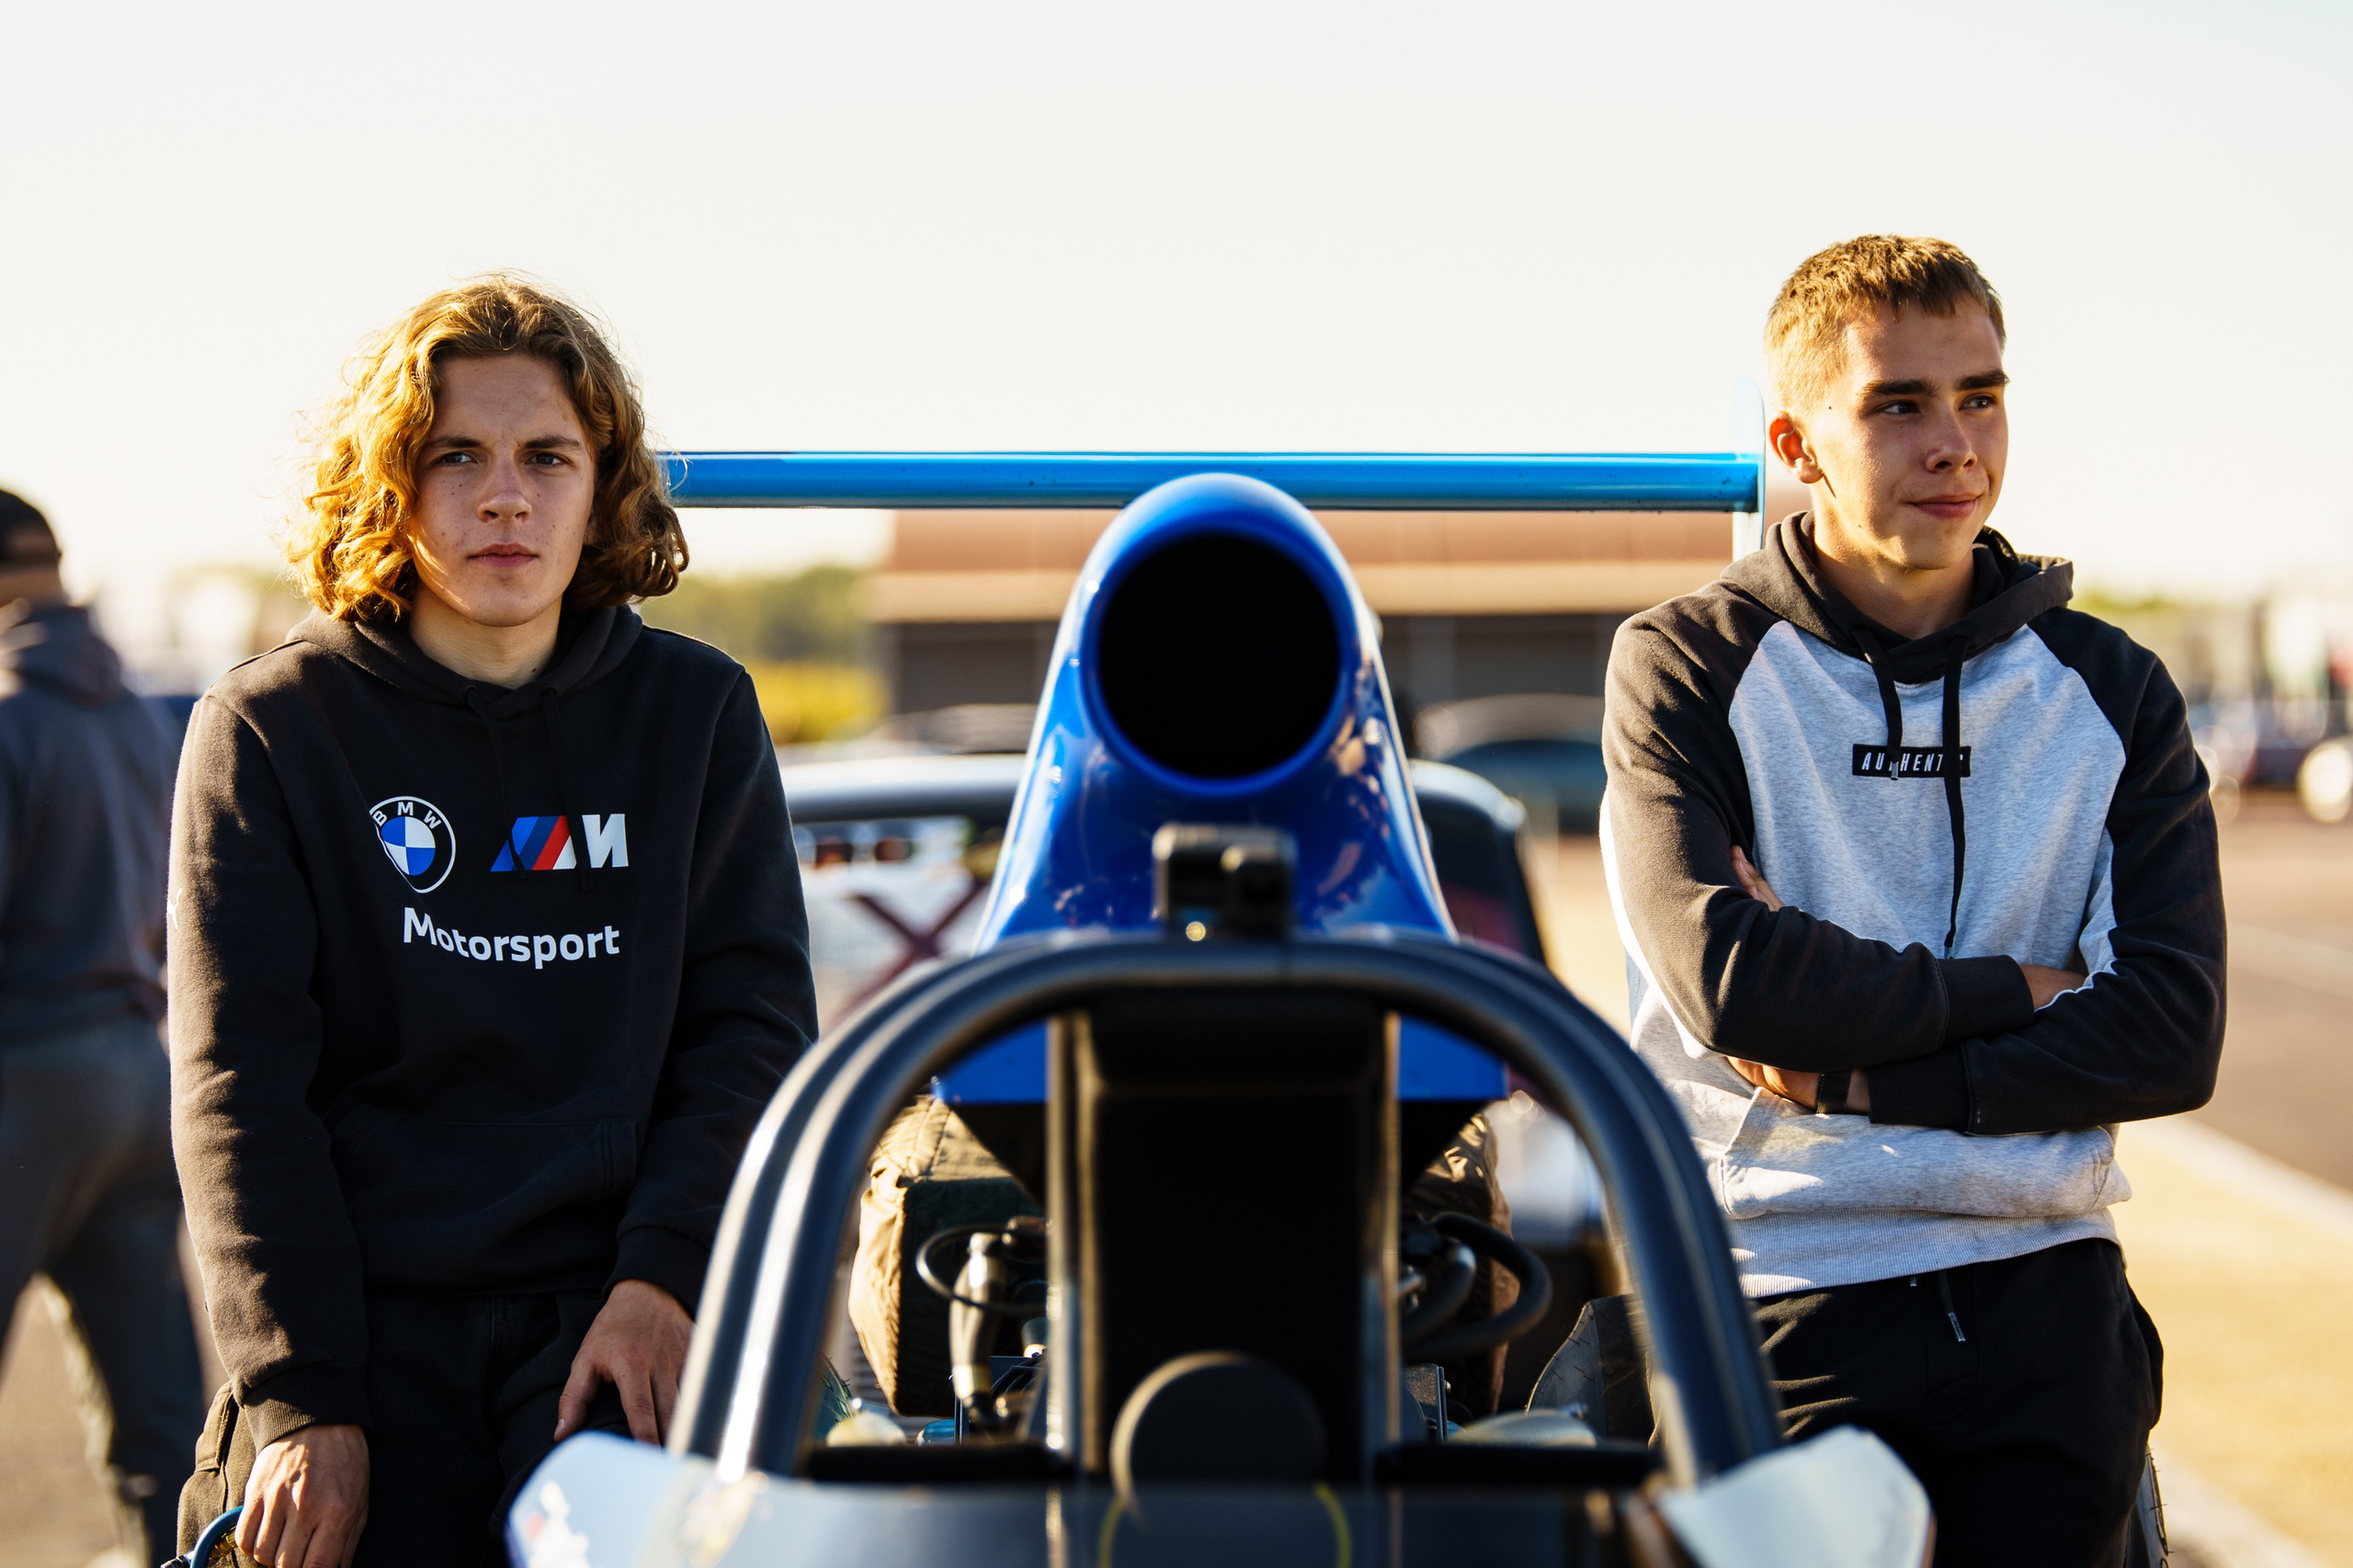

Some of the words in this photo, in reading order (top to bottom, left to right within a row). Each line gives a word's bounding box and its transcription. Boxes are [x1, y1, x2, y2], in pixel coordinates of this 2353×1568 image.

[1861, 752, 1964, 772] AUHENT
[372, 801, 442, 829] BMW
[403, 907, 620, 969] Motorsport
